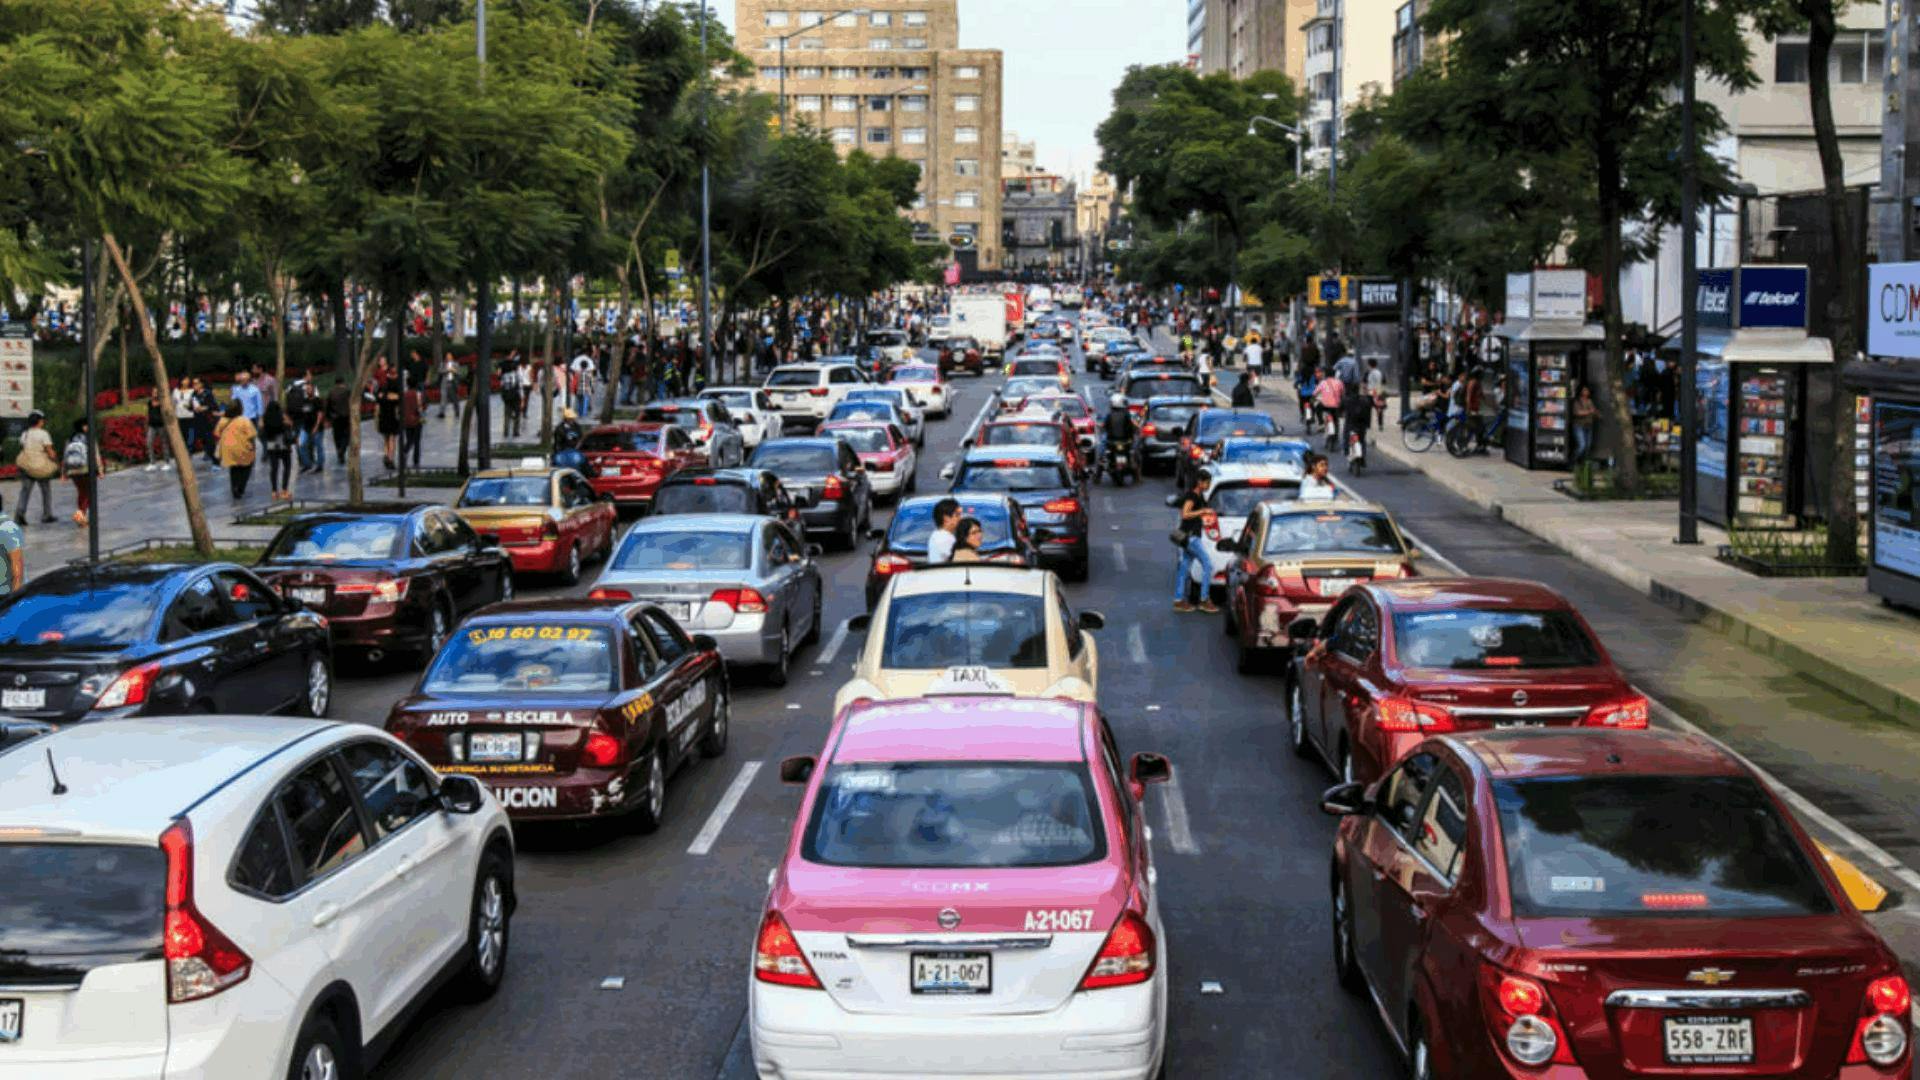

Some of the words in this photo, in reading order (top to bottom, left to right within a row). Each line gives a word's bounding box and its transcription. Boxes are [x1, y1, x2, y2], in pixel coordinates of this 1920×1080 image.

[1758, 291, 1801, 306] telcel
[951, 668, 986, 682] TAXI
[427, 711, 469, 726] AUTO
[504, 711, 574, 724] ESCUELA
[918, 963, 985, 982] A-21-067
[1670, 1028, 1749, 1051] 558-ZRF
